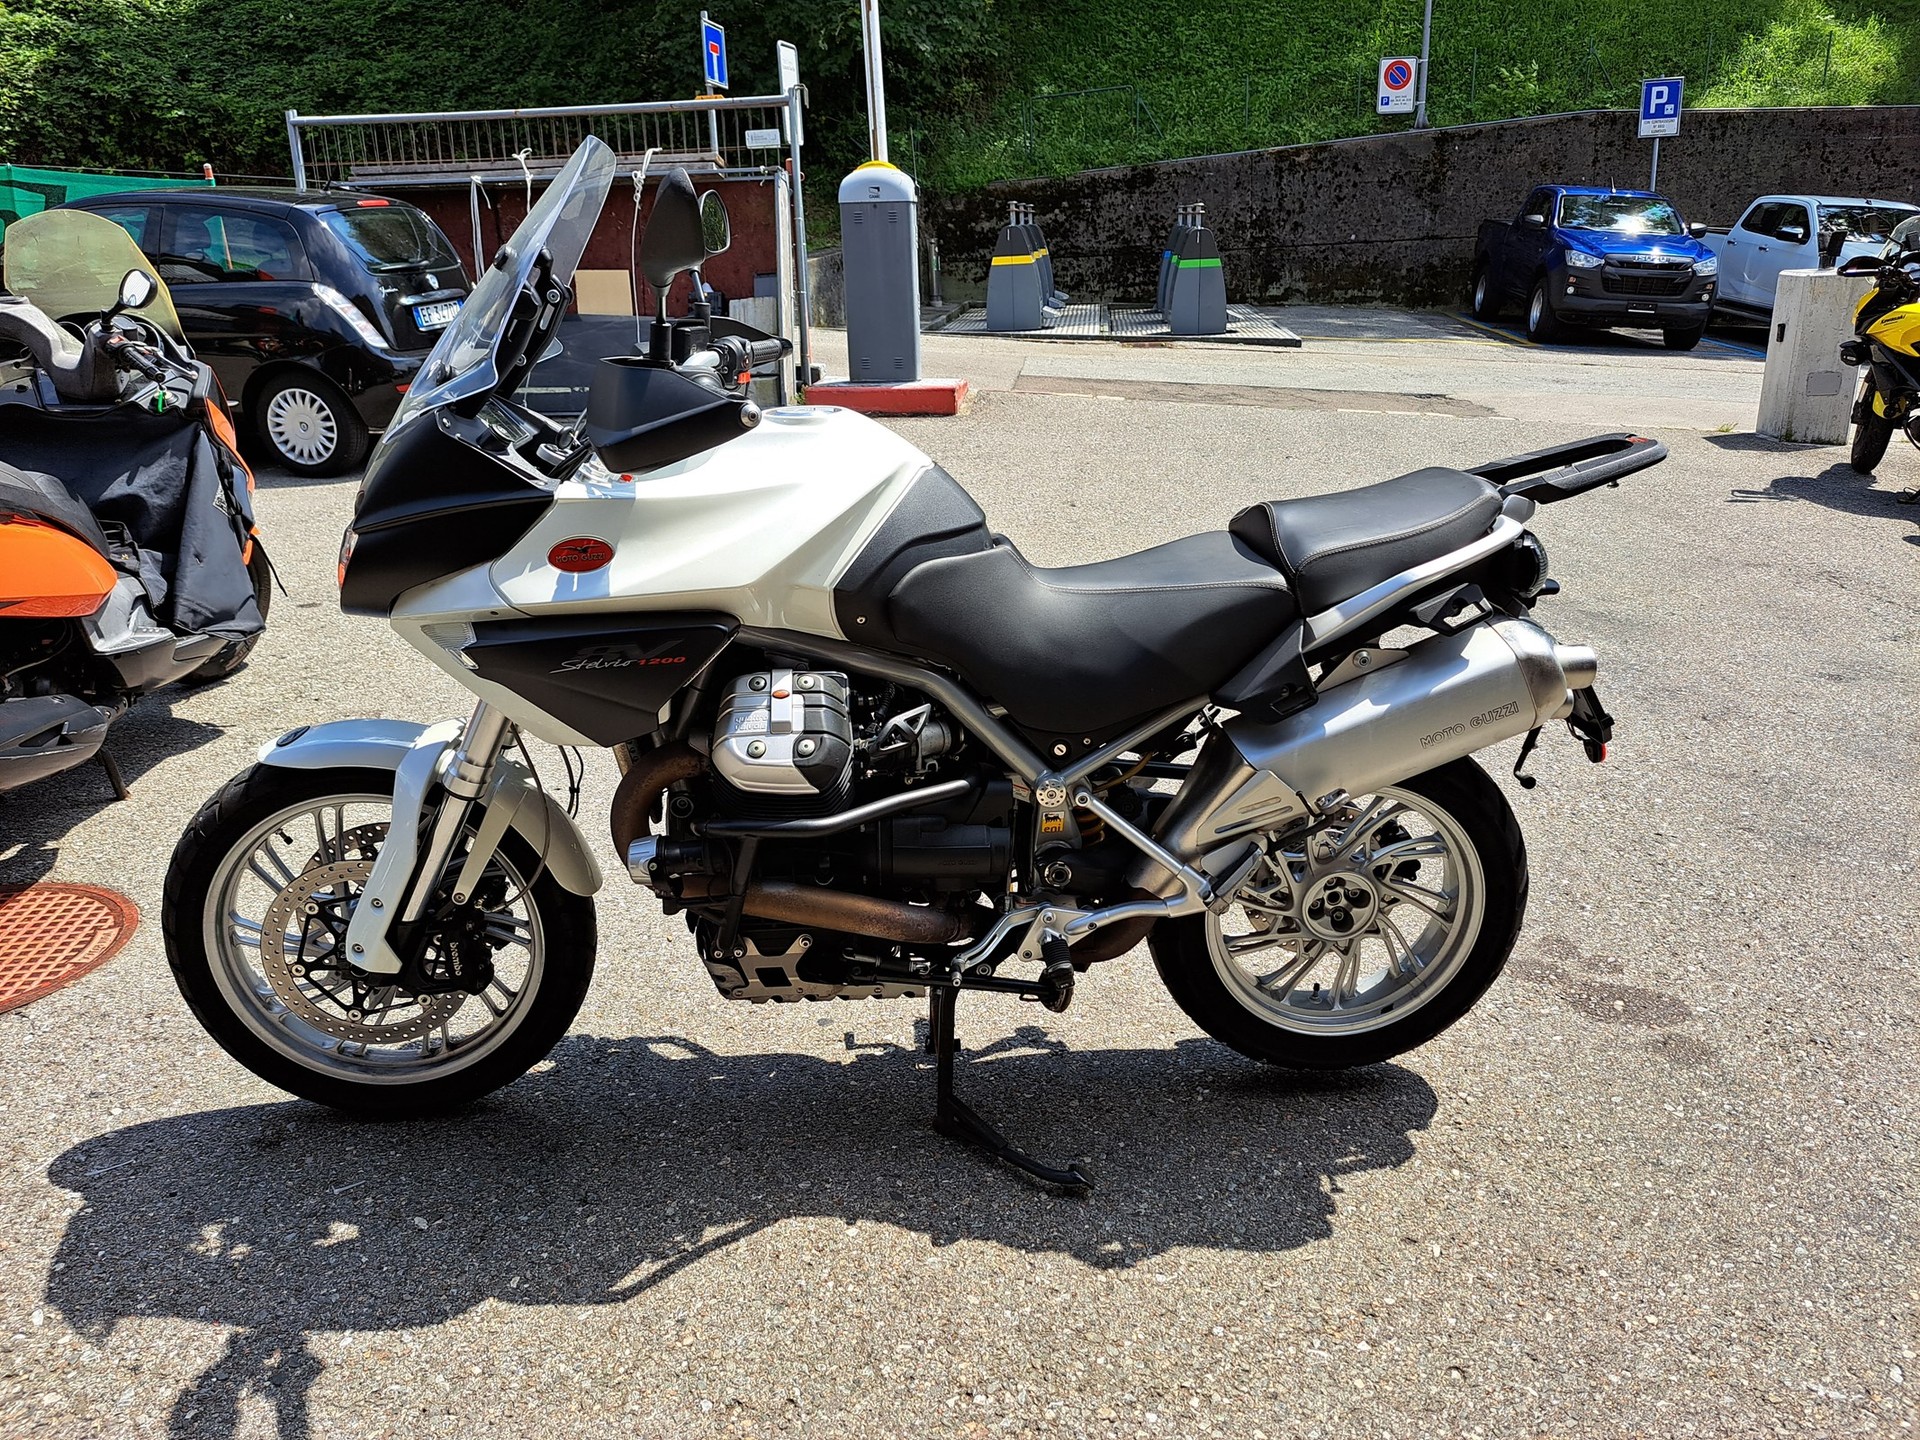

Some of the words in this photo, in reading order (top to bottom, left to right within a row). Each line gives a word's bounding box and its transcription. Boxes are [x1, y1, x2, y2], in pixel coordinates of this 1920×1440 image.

[1632, 255, 1670, 263] ISUZU
[1881, 314, 1906, 323] Kawasaki
[555, 554, 579, 563] MOTO
[581, 552, 606, 561] GUZZI
[549, 657, 638, 674] Stelvio
[638, 656, 686, 666] 1200
[1419, 723, 1466, 749] MOTO
[1470, 700, 1520, 729] GUZZI
[1043, 823, 1061, 833] eni
[449, 941, 463, 976] brembo
